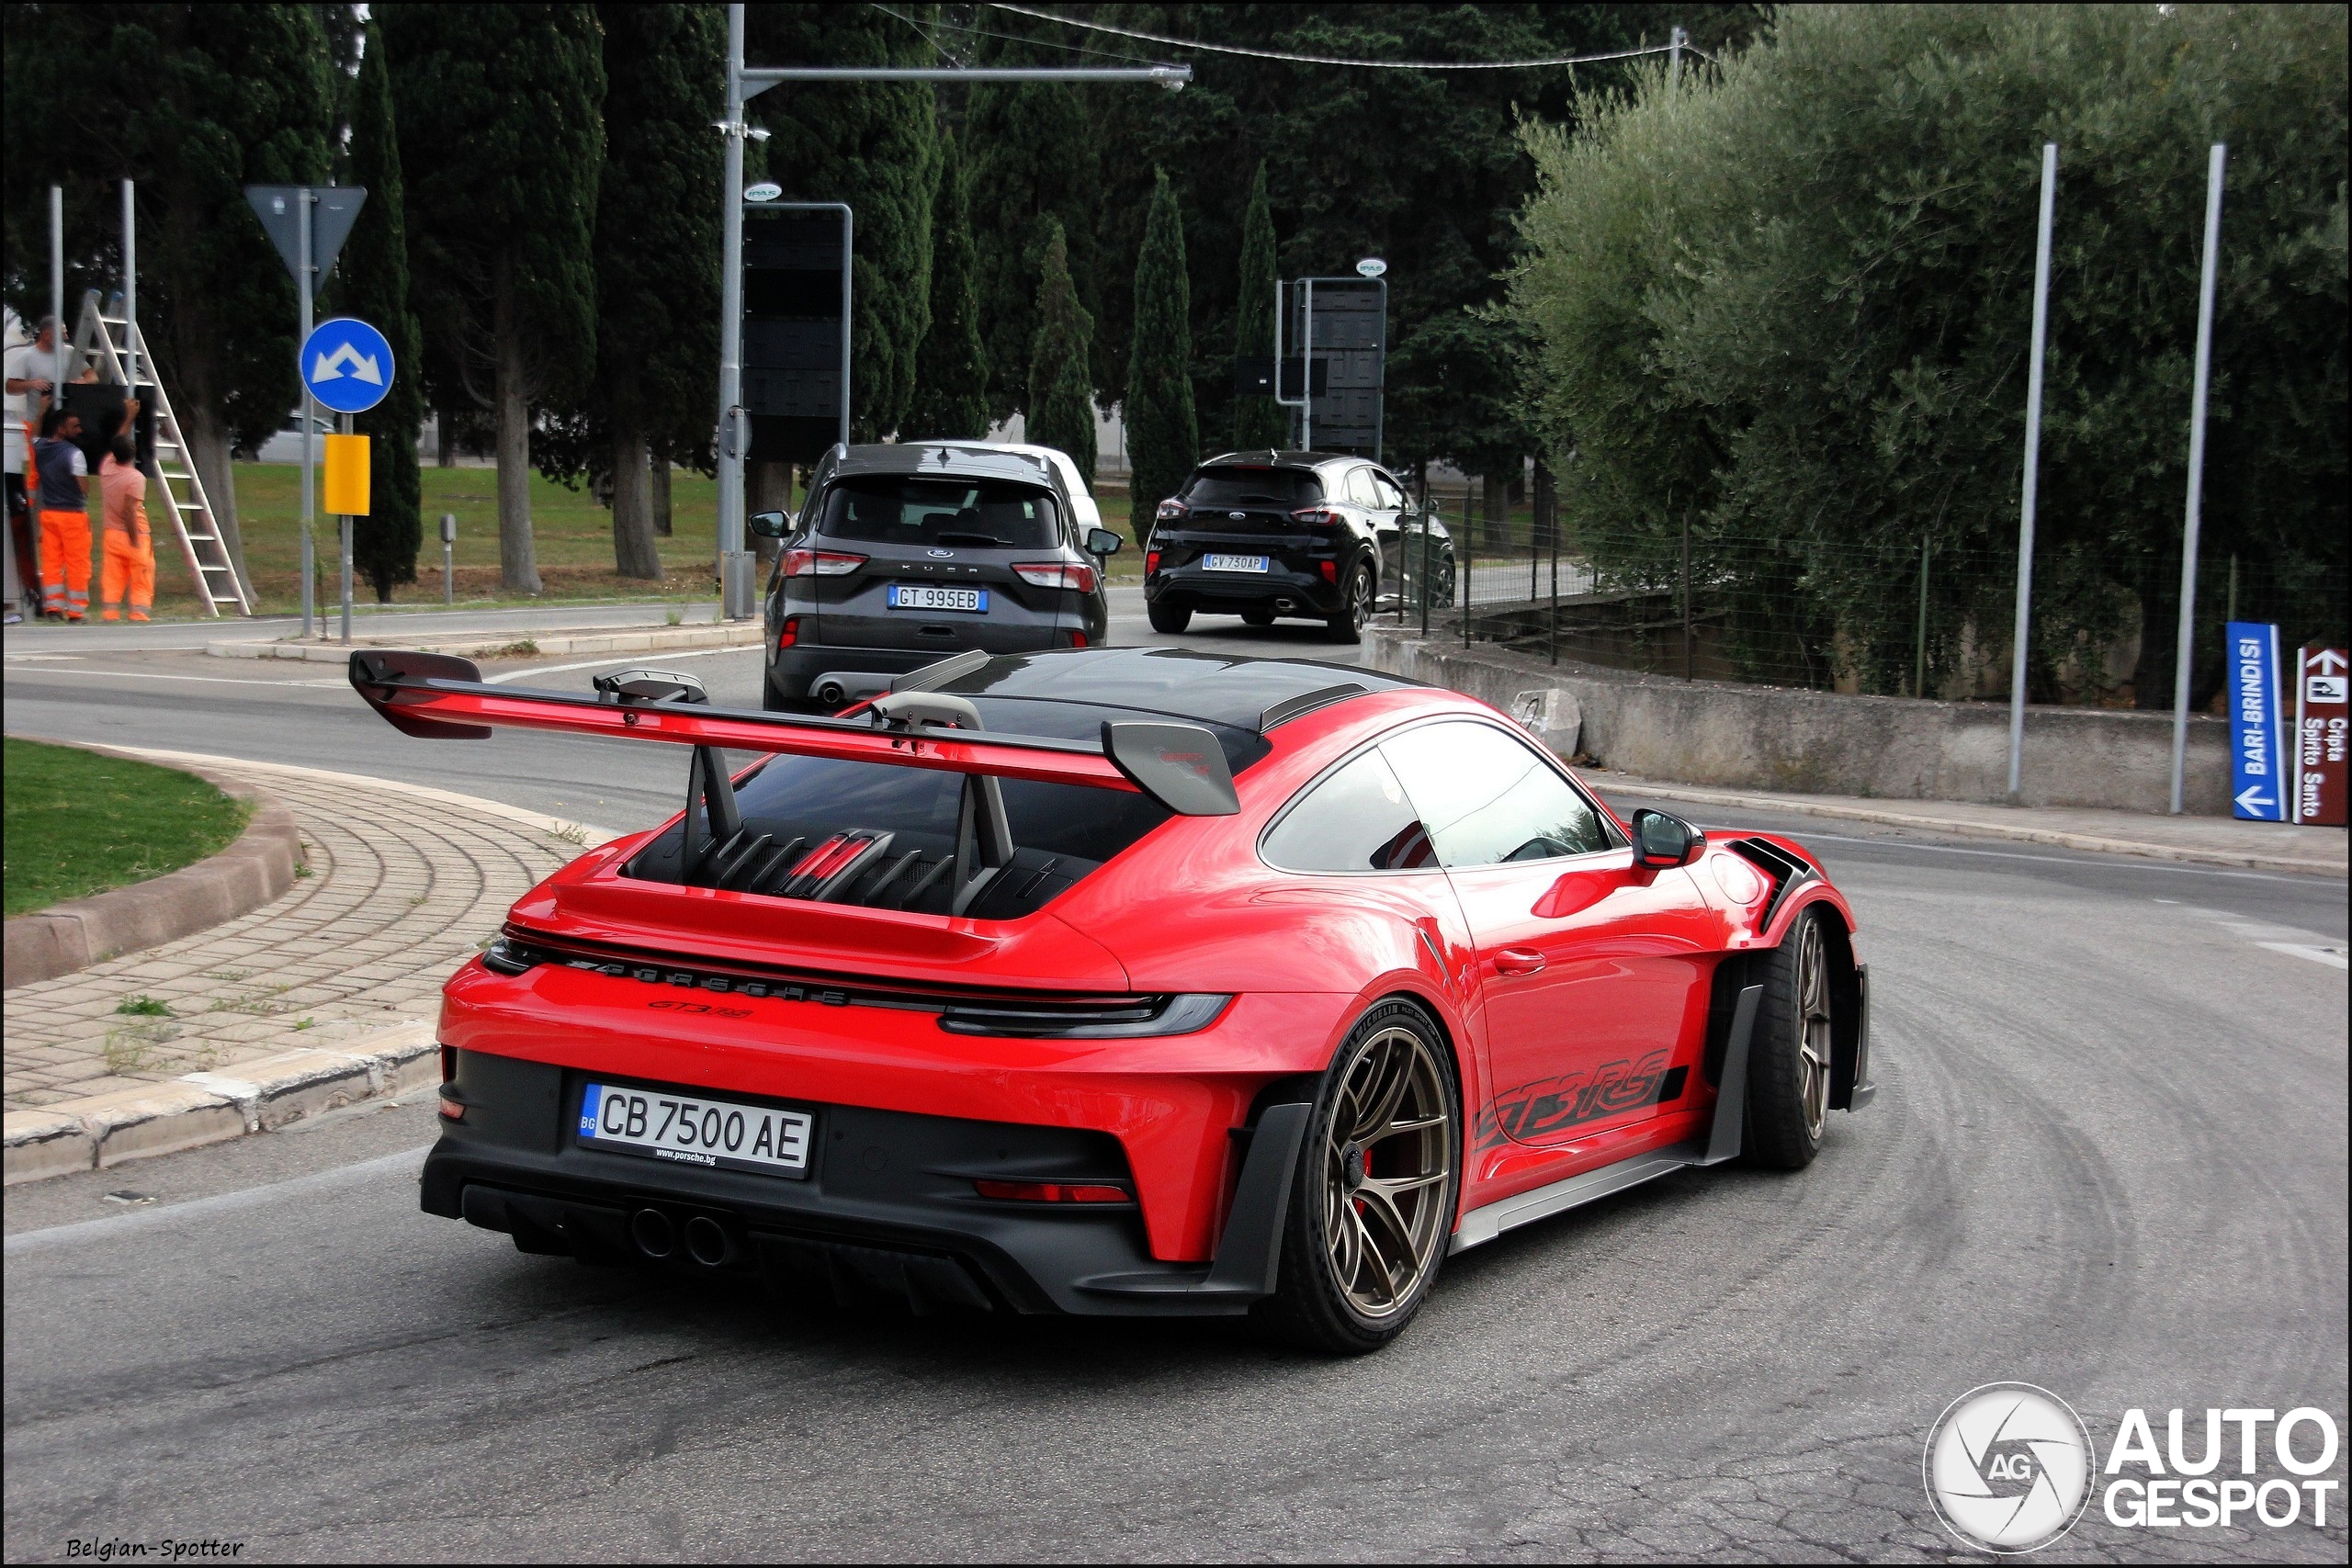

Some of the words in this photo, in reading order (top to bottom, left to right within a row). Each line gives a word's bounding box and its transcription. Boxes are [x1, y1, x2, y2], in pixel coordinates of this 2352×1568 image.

[1227, 557, 1261, 569] 730AP
[899, 589, 919, 605] GT
[926, 590, 977, 608] 995EB
[2238, 638, 2268, 776] BARI-BRINDISI
[2301, 717, 2325, 766] Spirito
[2324, 717, 2348, 762] Cripta
[2302, 772, 2325, 818] Santo
[605, 964, 848, 1005] PORSCHE
[1355, 1004, 1398, 1040] MICHELIN
[581, 1116, 595, 1129] BG
[603, 1094, 649, 1137] CB
[655, 1100, 745, 1152] 7500
[752, 1115, 804, 1161] AE
[656, 1148, 716, 1166] www.porsche.bg
